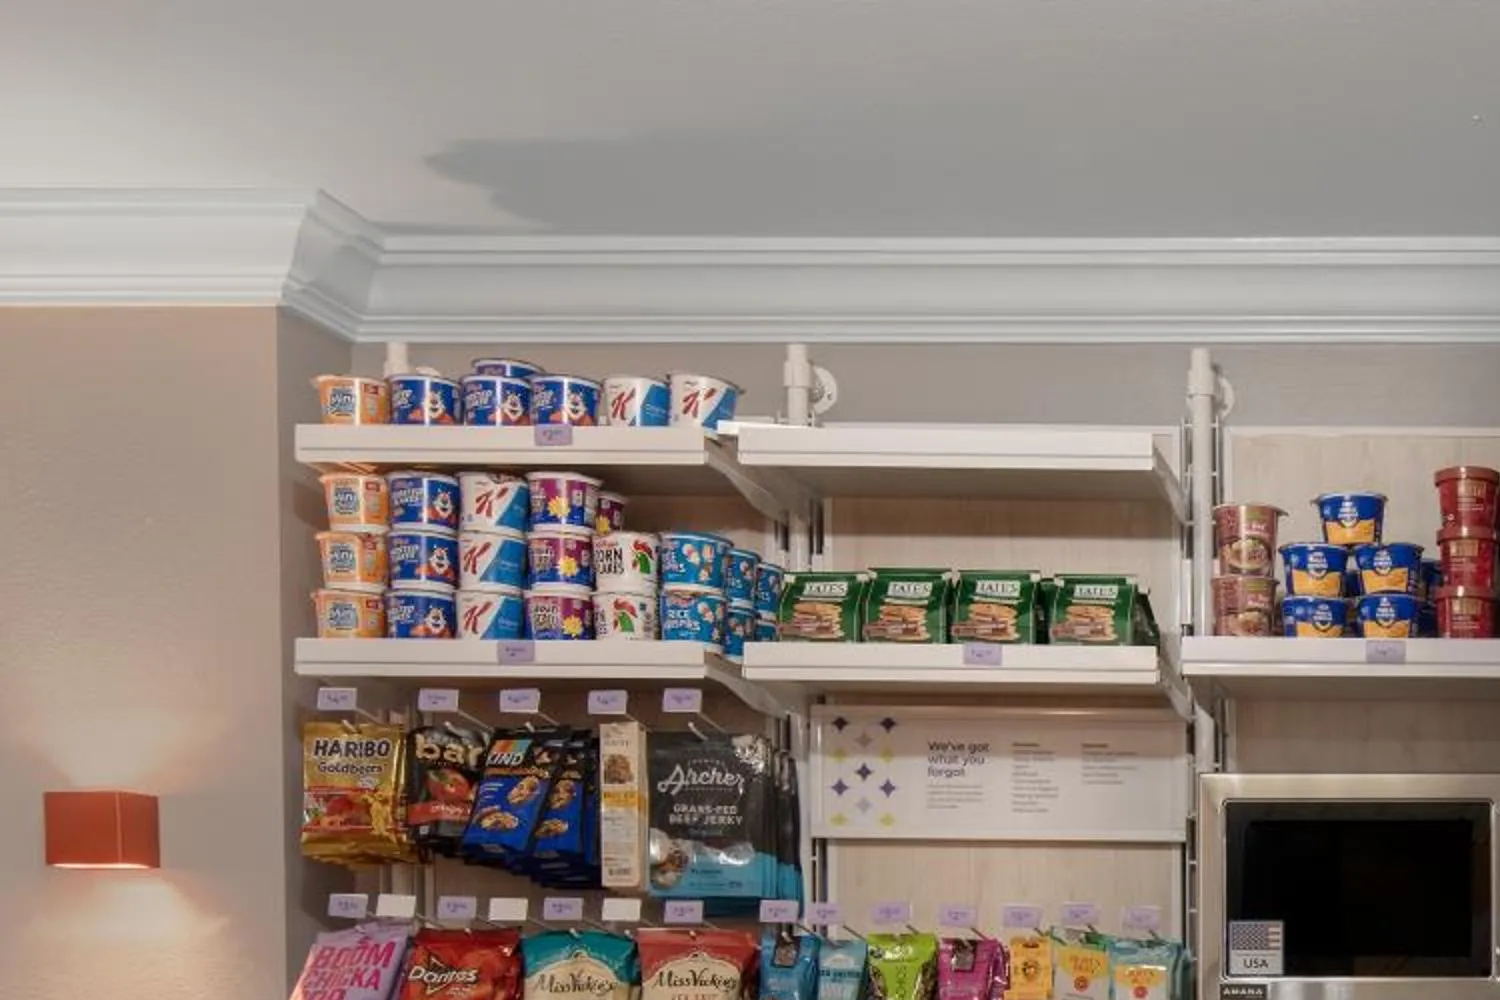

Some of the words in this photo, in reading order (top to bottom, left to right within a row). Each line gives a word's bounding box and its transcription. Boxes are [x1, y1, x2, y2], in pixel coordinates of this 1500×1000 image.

[314, 739, 391, 758] HARIBO
[314, 941, 396, 970] BOOM
[1243, 957, 1268, 969] USA
[408, 965, 479, 984] Doritos
